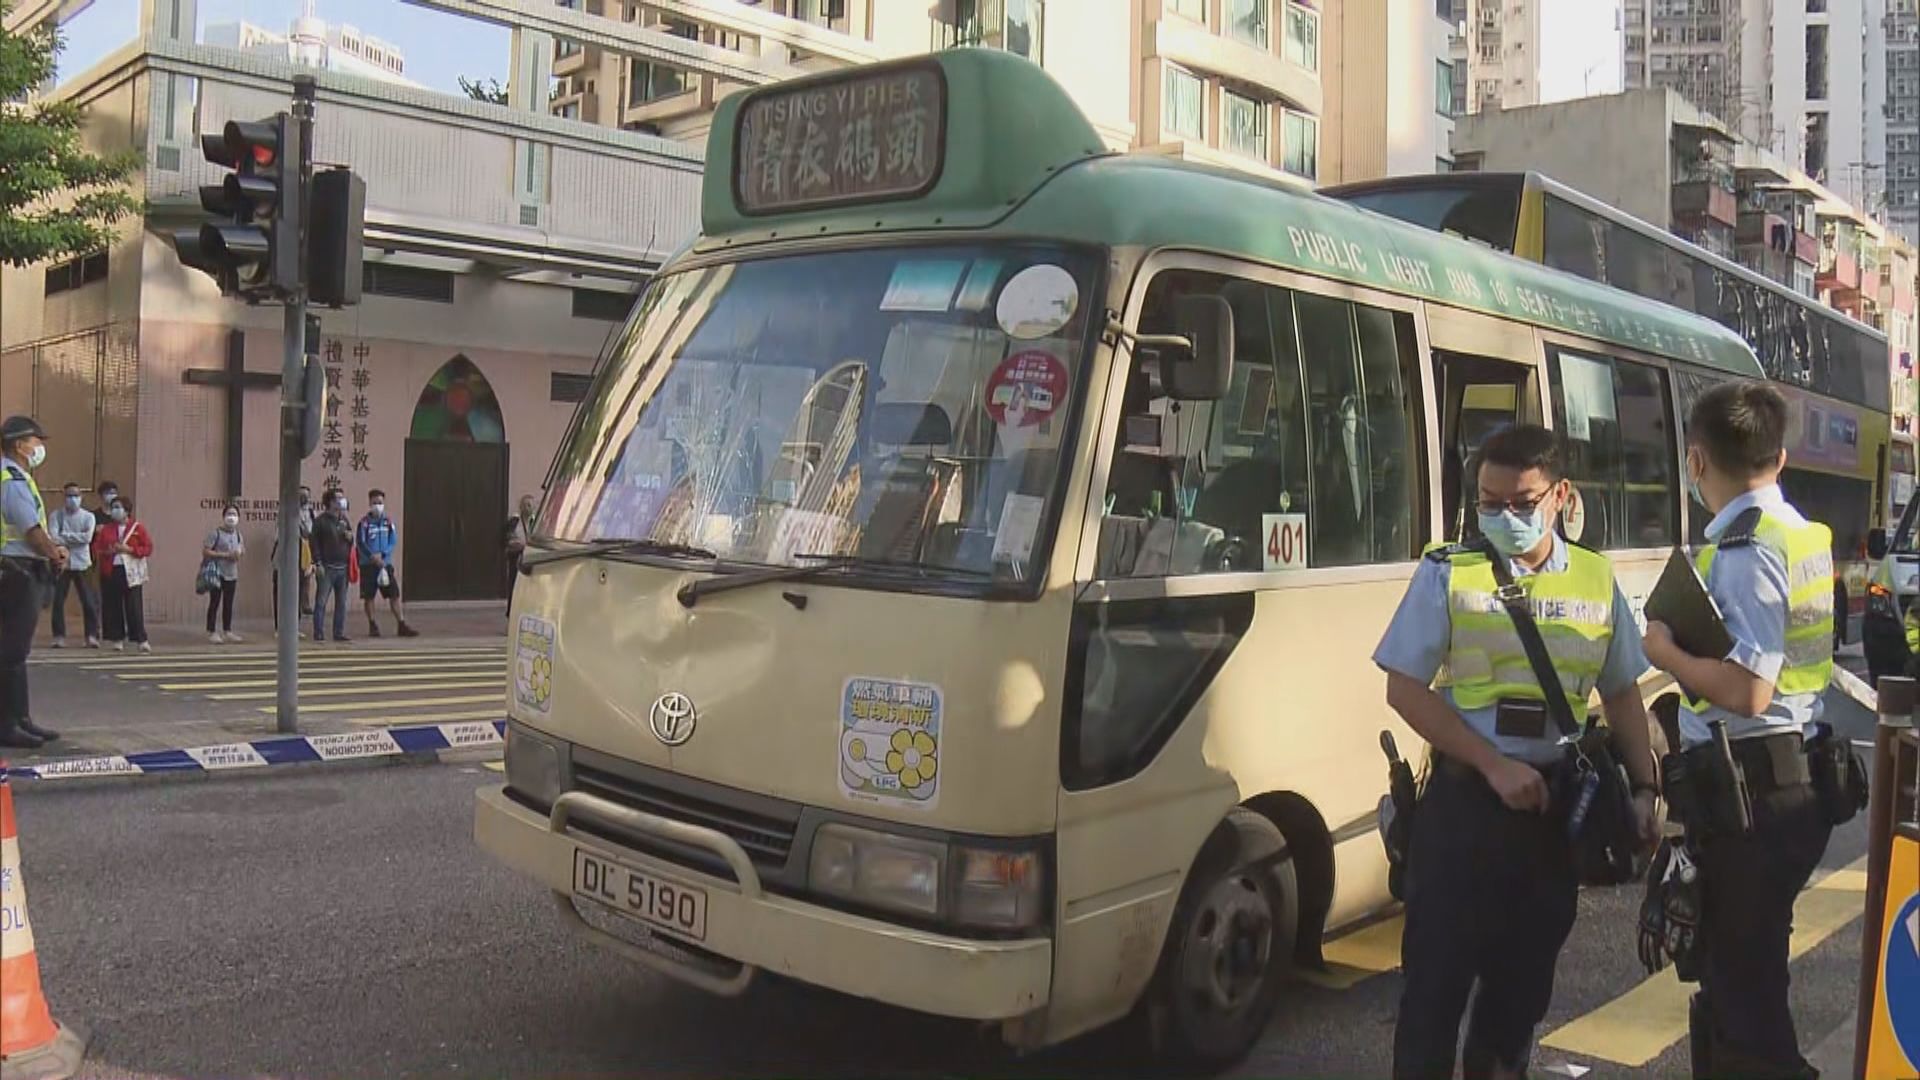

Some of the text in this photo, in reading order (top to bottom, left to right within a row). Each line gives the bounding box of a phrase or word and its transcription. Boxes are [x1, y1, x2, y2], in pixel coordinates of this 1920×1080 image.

[762, 80, 920, 123] TSING YI PIER
[1288, 226, 1368, 275] PUBLIC
[1378, 249, 1437, 291] LIGHT
[1445, 266, 1482, 301] BUS
[1515, 285, 1565, 321] SEATS
[351, 341, 371, 472] 中華基督教
[1267, 521, 1304, 565] 401
[325, 742, 395, 757] POLICE CORDON
[876, 778, 897, 789] LPG
[584, 858, 696, 929] DL 5190
